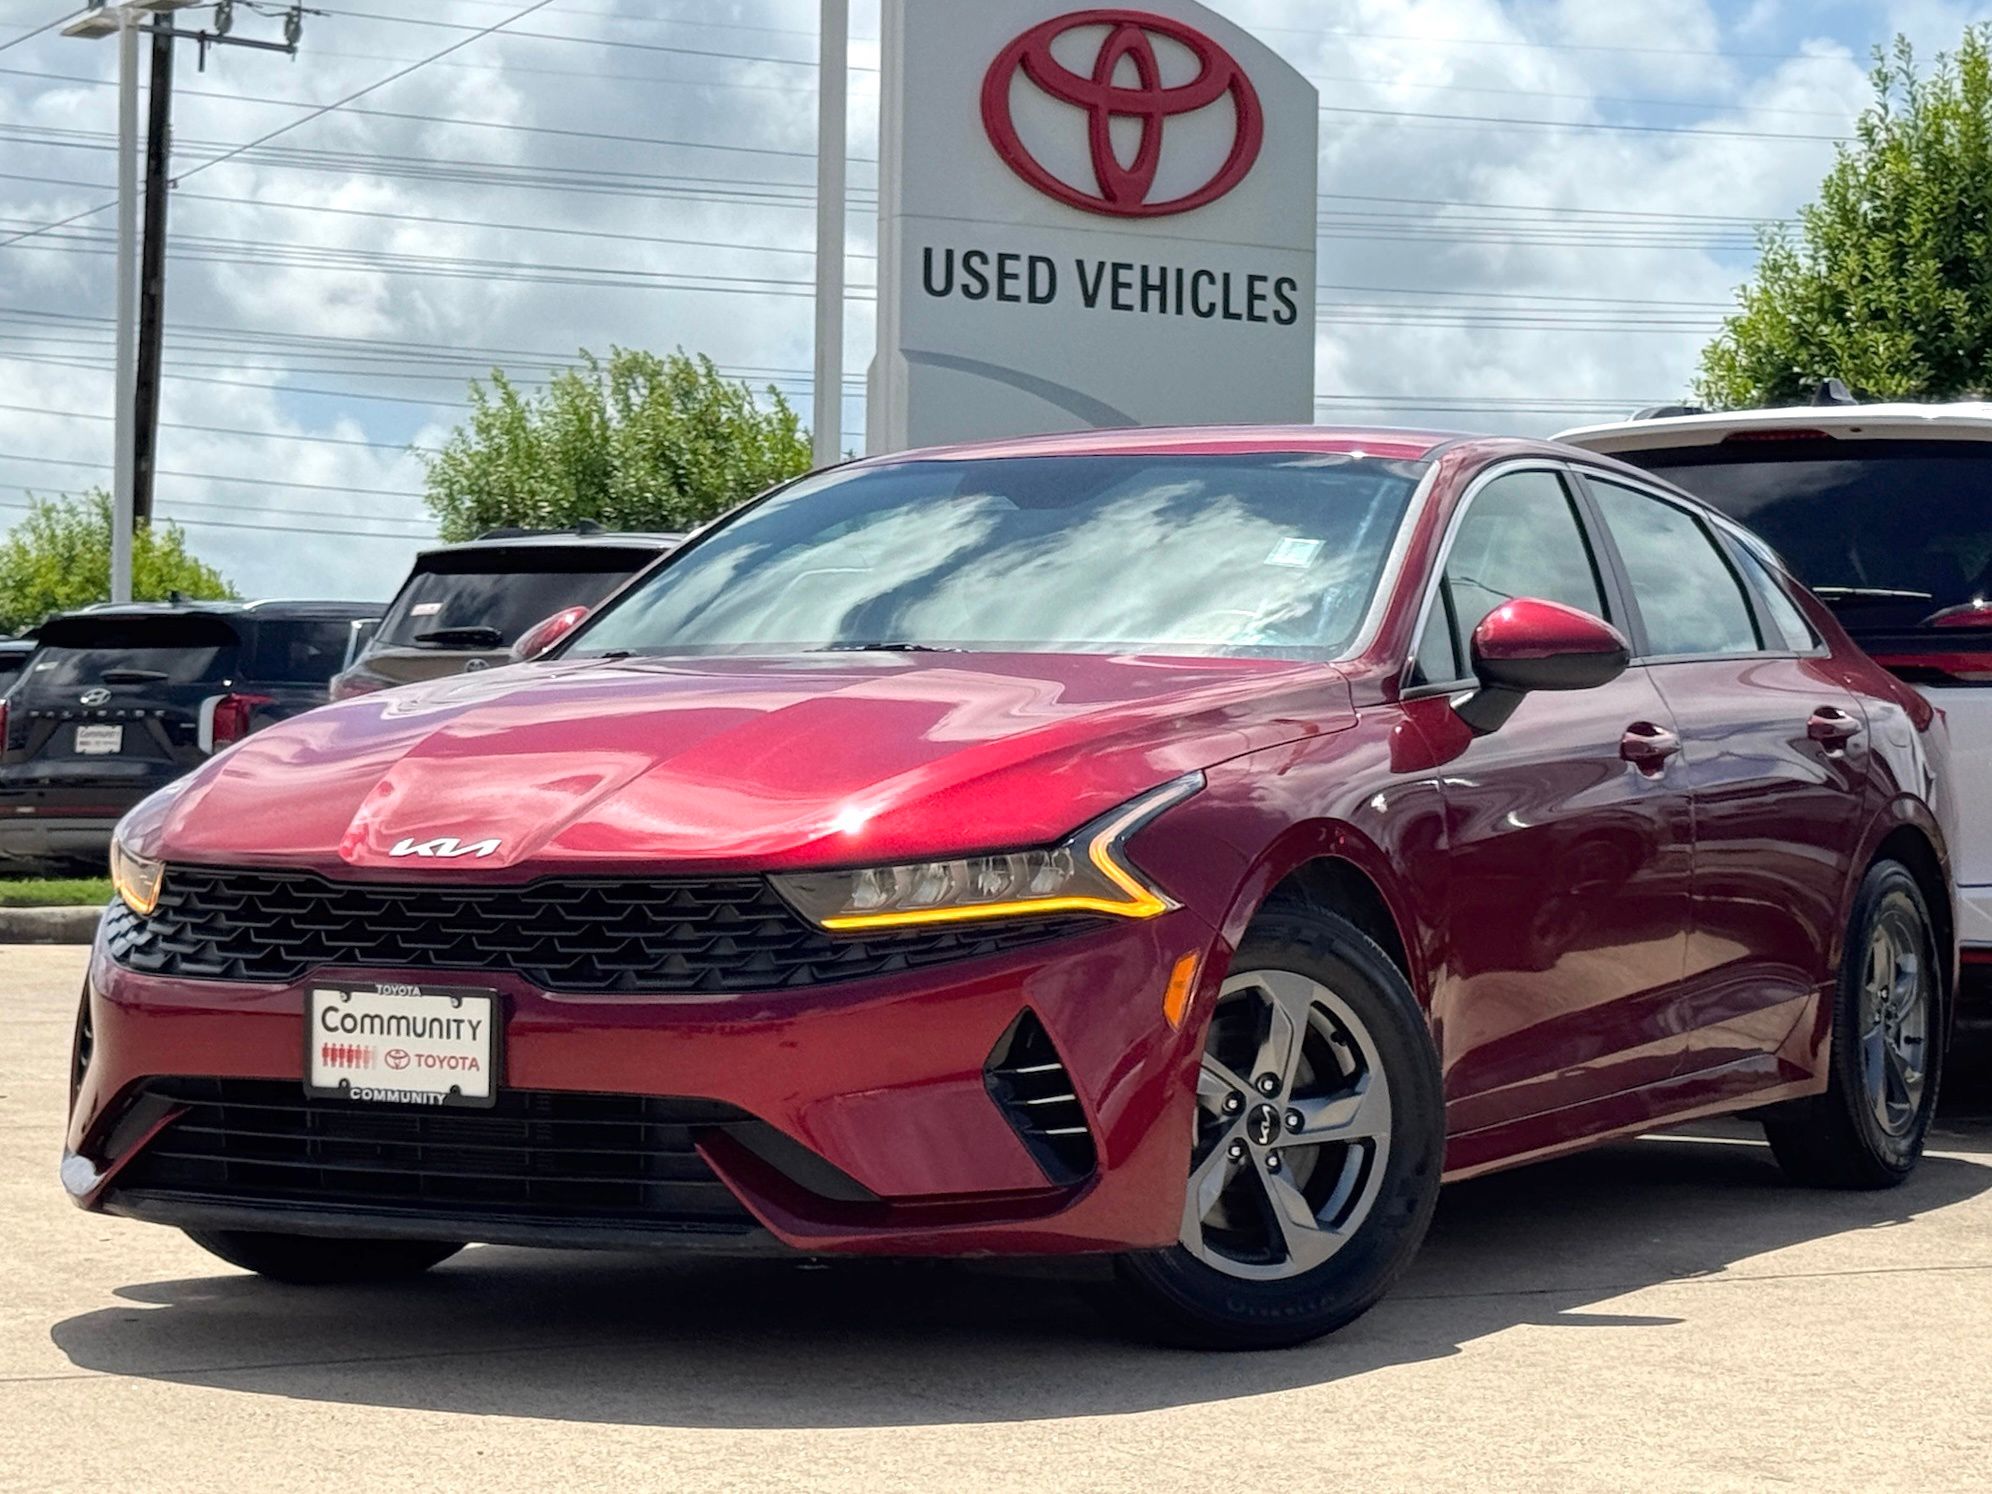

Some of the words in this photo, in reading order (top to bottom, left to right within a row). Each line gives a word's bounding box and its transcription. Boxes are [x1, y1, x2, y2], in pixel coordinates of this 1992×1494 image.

[922, 247, 1057, 305] USED
[1075, 259, 1298, 326] VEHICLES
[389, 837, 502, 858] KIA
[375, 984, 422, 996] TOYOTA
[414, 1053, 480, 1072] TOYOTA
[349, 1088, 447, 1106] COMMUNITY
